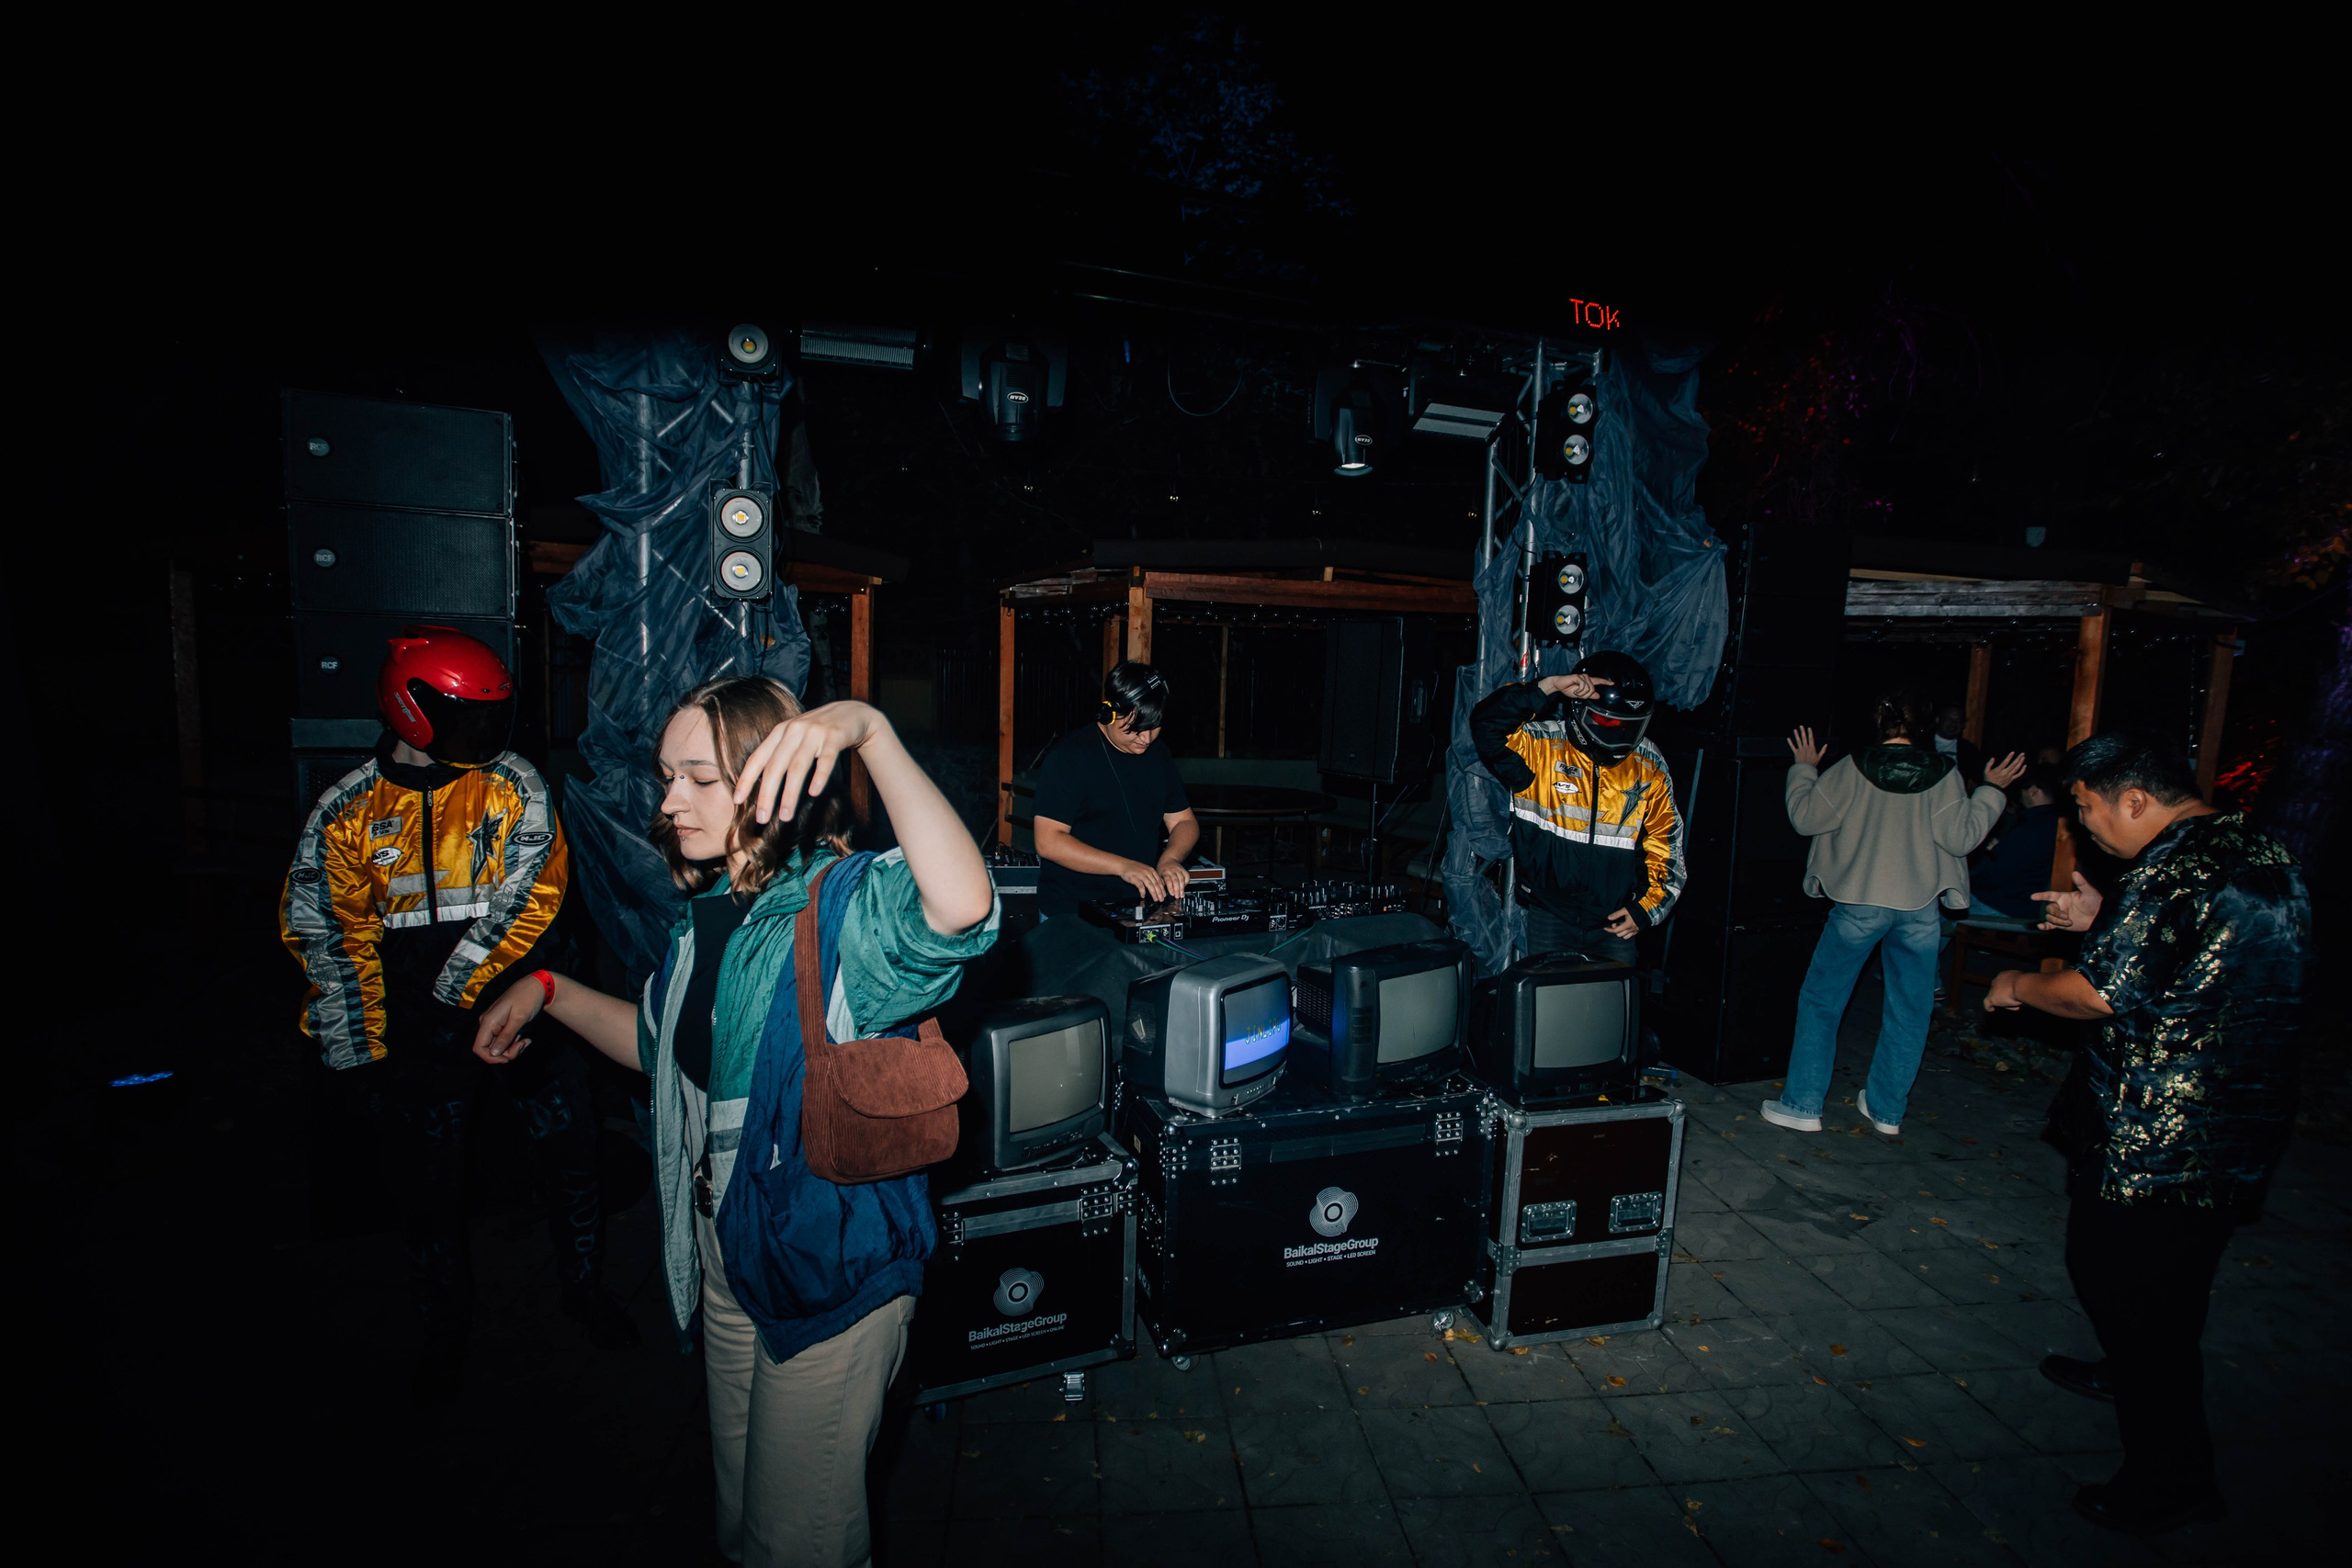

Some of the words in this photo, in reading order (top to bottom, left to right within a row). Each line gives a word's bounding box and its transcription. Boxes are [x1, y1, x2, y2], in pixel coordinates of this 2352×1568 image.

[310, 442, 327, 450] RCF
[1283, 1237, 1378, 1259] BaikalStageGroup
[1286, 1259, 1304, 1268] SOUND
[1357, 1249, 1375, 1258] SCREEN
[968, 1313, 1067, 1342] BaikalStageGroup
